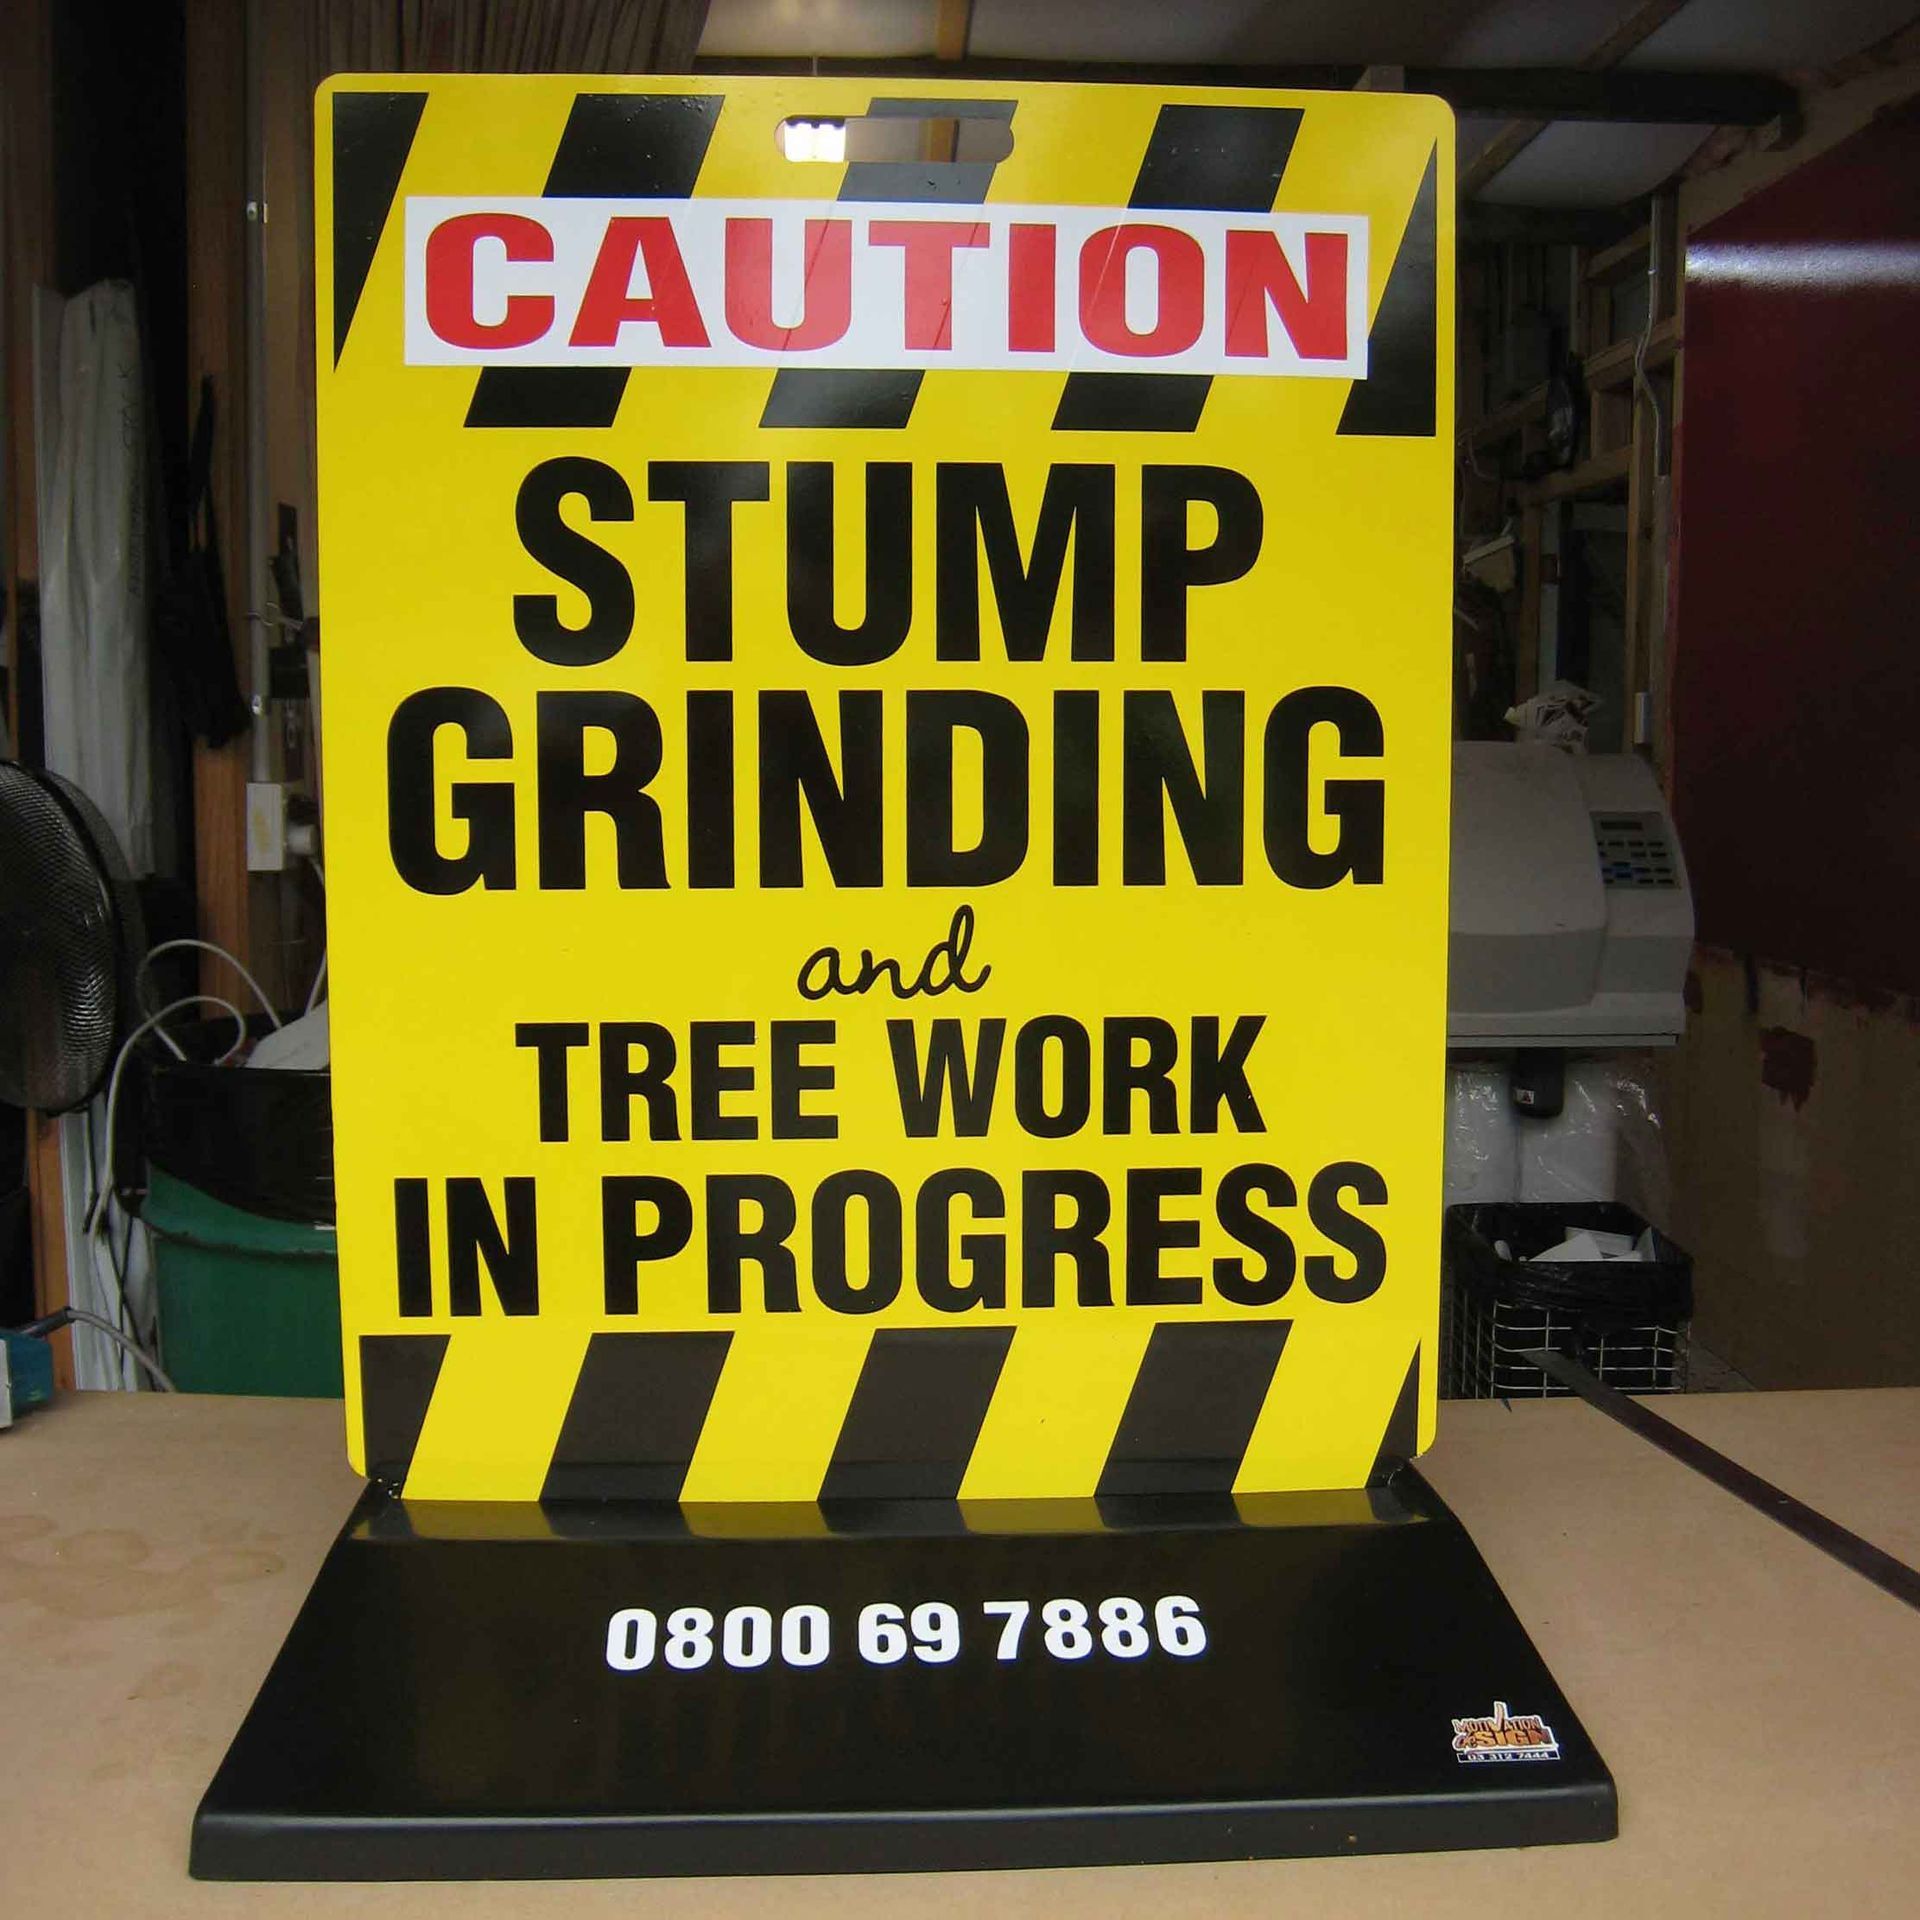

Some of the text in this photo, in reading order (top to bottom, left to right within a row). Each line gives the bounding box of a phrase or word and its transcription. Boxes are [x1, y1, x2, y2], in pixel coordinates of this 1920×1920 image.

[426, 214, 1348, 359] CAUTION
[514, 456, 1263, 666] STUMP
[387, 686, 1384, 895] GRINDING
[798, 905, 991, 1000] and
[516, 1015, 1266, 1142] TREE WORK
[395, 1162, 1388, 1317] IN PROGRESS
[606, 1596, 1207, 1671] 0800 69 7886
[1454, 1704, 1541, 1732] MOTIVATION
